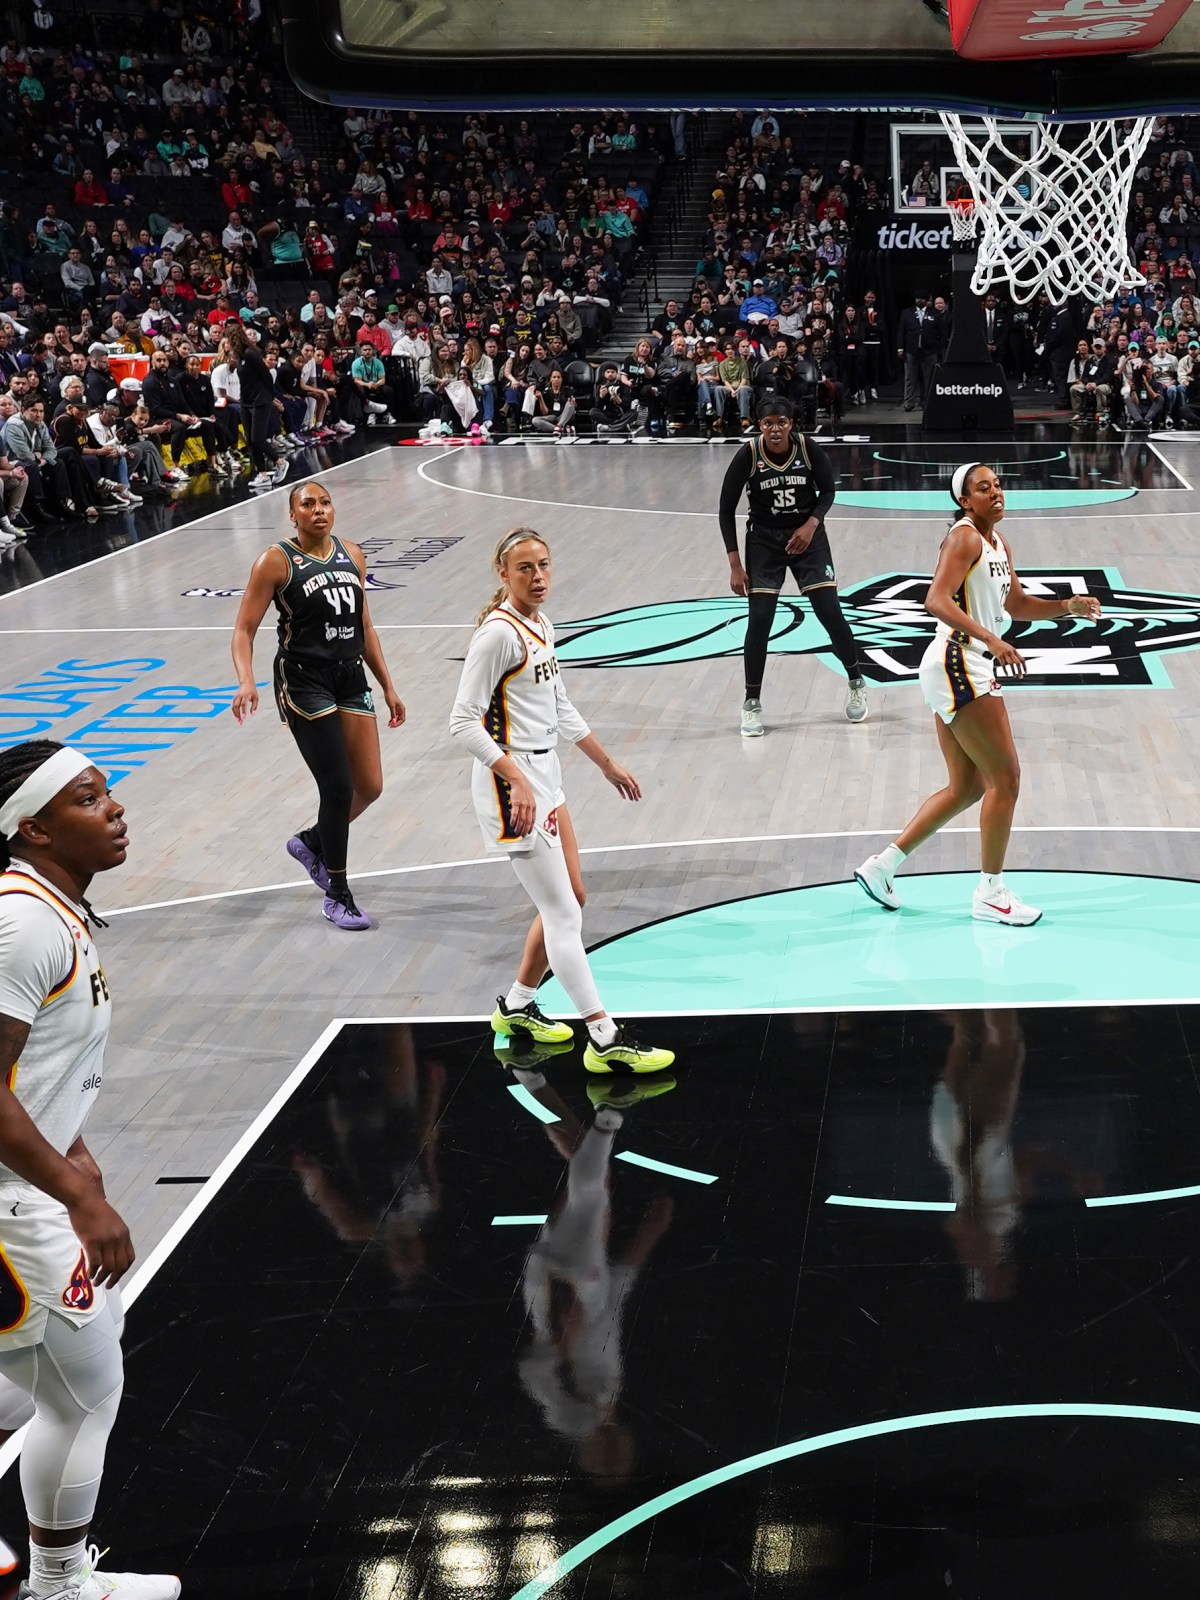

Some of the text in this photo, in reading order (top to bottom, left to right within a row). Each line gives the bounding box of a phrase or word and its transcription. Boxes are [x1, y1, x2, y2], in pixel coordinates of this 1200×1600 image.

[936, 384, 1003, 397] betterhelp
[760, 475, 807, 490] NEW YORK
[773, 488, 796, 508] 35
[989, 562, 1010, 578] FEVE
[302, 572, 328, 598] NEW
[322, 586, 356, 615] 44
[533, 655, 559, 684] FEVE
